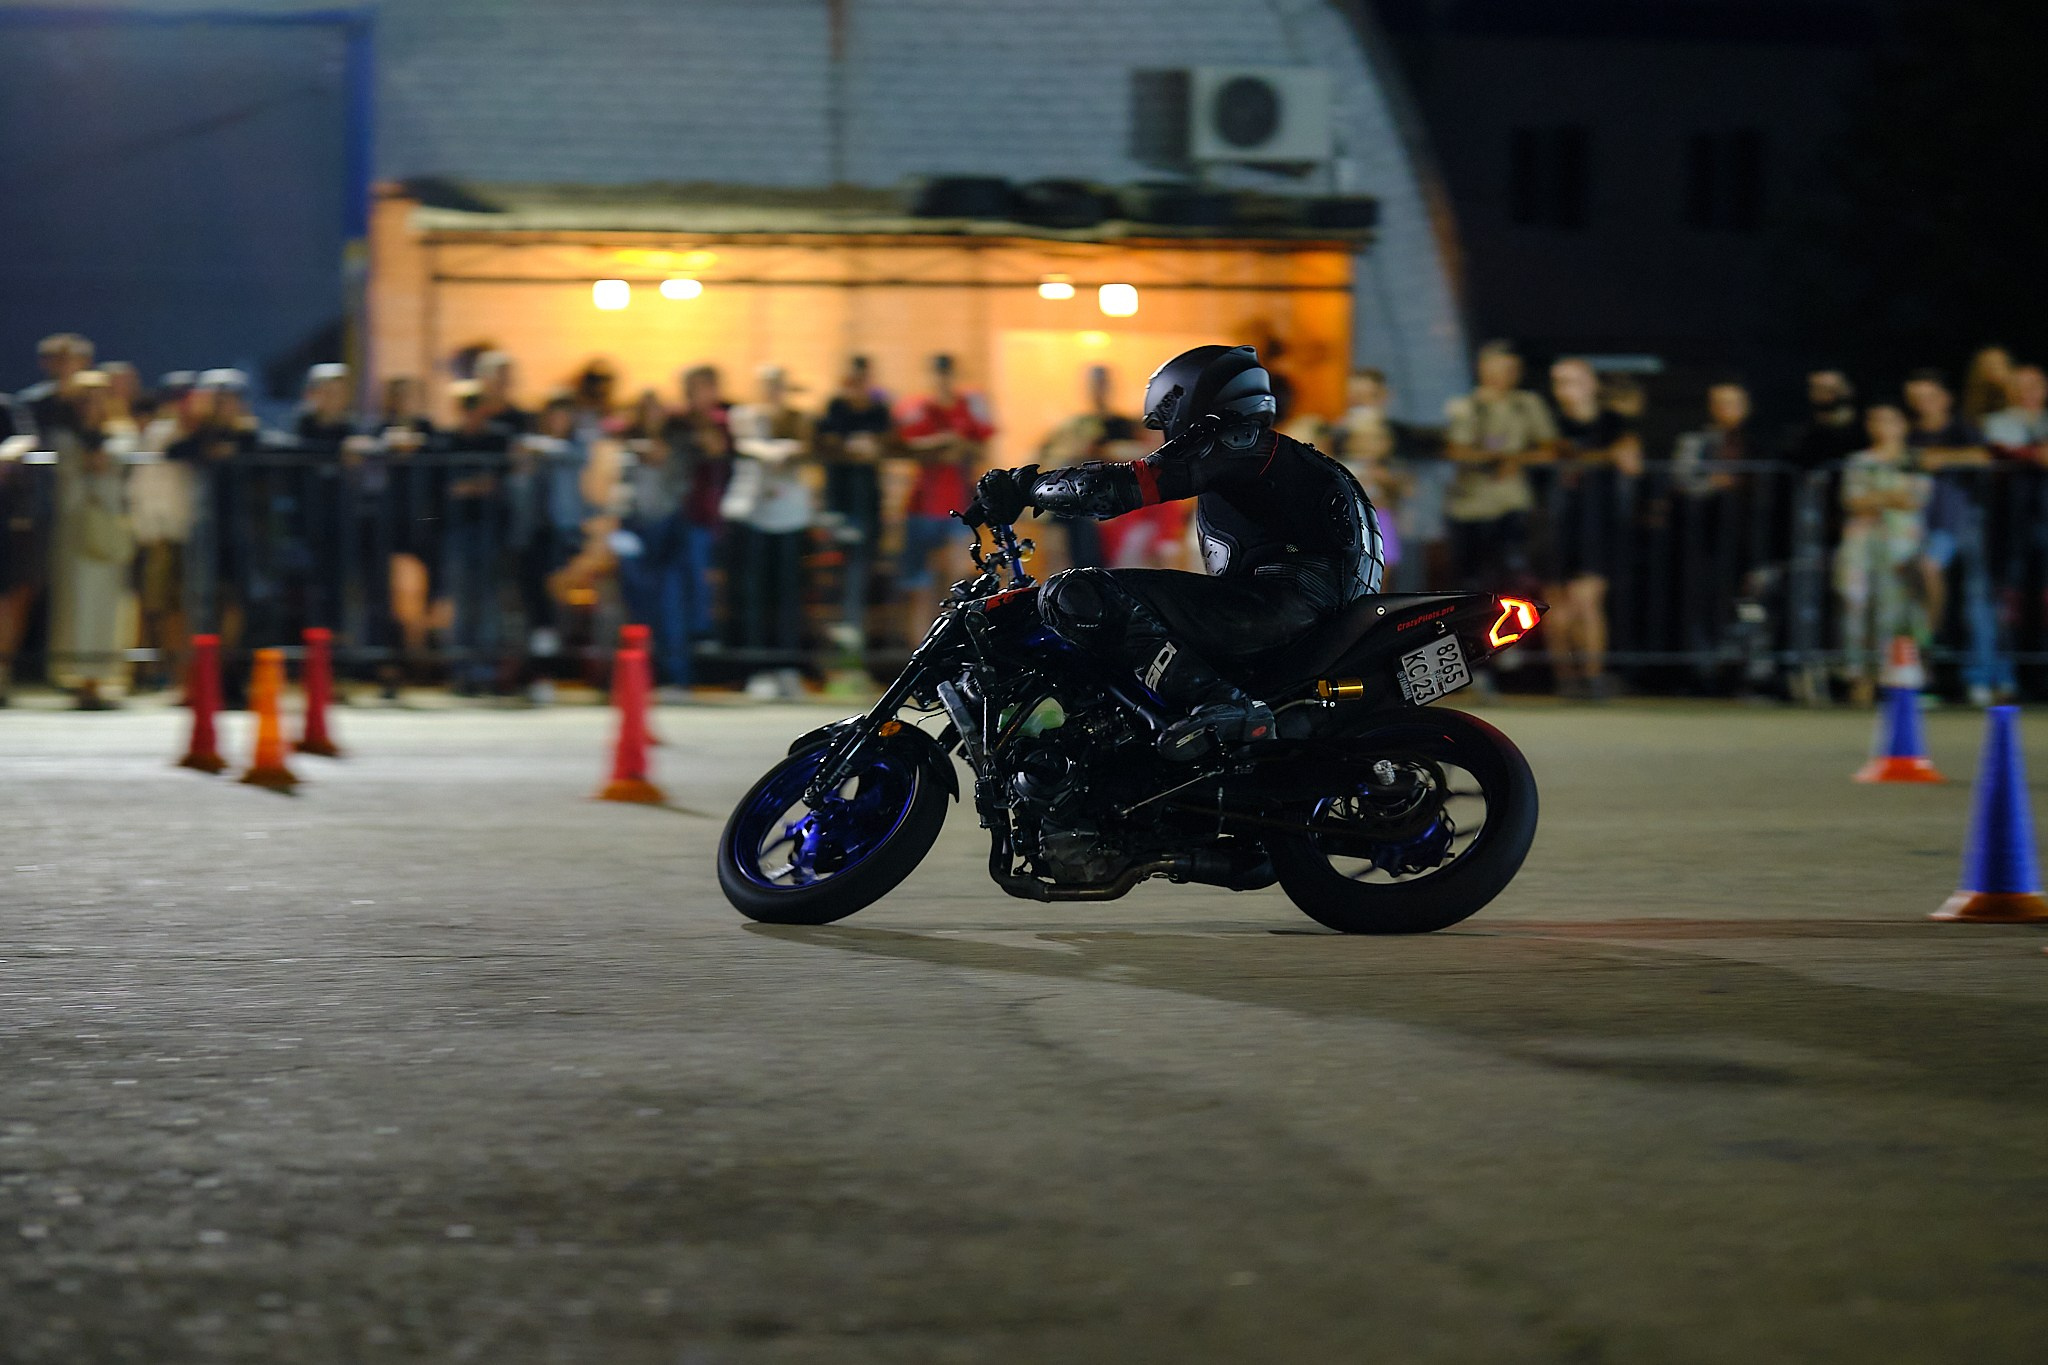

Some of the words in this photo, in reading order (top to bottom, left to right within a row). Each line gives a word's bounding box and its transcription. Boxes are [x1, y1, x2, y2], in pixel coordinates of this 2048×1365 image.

[1404, 650, 1428, 678] KC
[1436, 643, 1464, 684] 8265
[1412, 678, 1435, 700] 23
